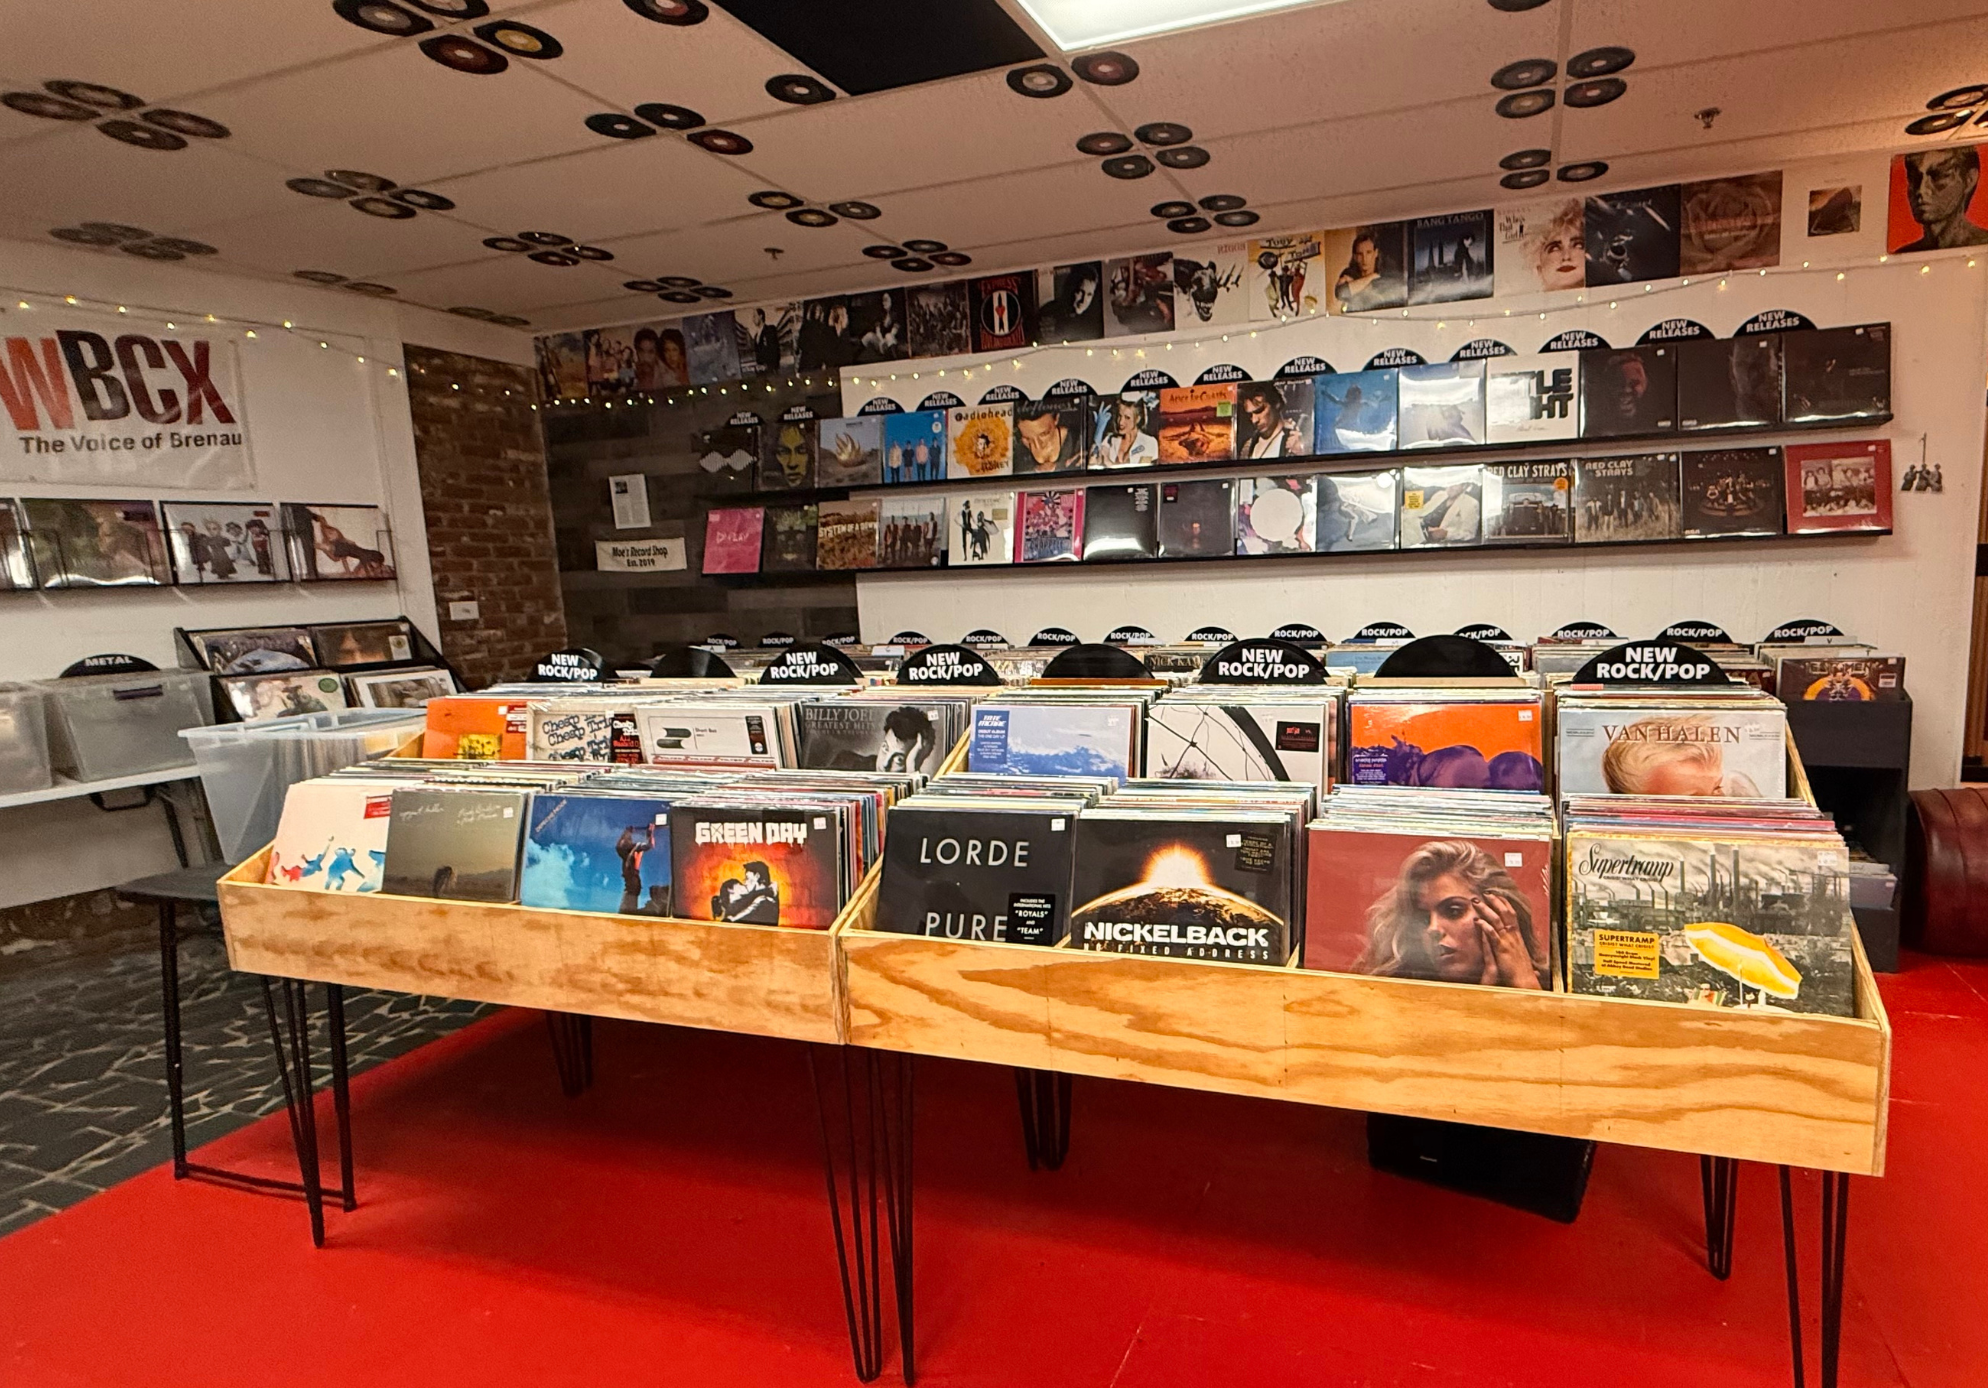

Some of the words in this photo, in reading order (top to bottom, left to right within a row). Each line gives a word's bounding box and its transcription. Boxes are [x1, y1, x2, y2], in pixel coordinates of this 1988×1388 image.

[1759, 311, 1785, 322] NEW
[1662, 319, 1687, 330] NEW
[1746, 317, 1801, 332] RELEASES
[1561, 331, 1586, 340] NEW
[1649, 326, 1700, 339] RELEASES
[1471, 340, 1494, 349] NEW
[1550, 338, 1599, 350] RELEASES
[1384, 350, 1406, 358] NEW
[1460, 346, 1506, 357] RELEASES
[1294, 357, 1316, 366] NEW
[1373, 355, 1417, 366] RELEASES
[1212, 364, 1232, 373] NEW
[1284, 362, 1326, 373] RELEASES
[1140, 370, 1158, 379] NEW
[1203, 371, 1243, 382] RELEASES
[0, 330, 237, 431] WBCX
[1060, 379, 1078, 387] NEW
[1130, 377, 1168, 387] RELEASES
[1051, 385, 1087, 395] RELEASES
[985, 392, 1019, 401] RELEASES
[865, 403, 896, 412] RELEASES
[924, 398, 957, 407] RELEASES
[730, 416, 759, 425] RELEASES
[783, 411, 813, 420] RELEASES
[18, 437, 65, 454] The
[70, 435, 135, 451] Voice
[141, 434, 162, 449] of
[170, 432, 242, 448] Brenau
[1507, 464, 1529, 478] CLAY
[1532, 463, 1568, 478] STRAYS
[1585, 462, 1606, 471] RED
[1608, 460, 1634, 469] CLAY
[1595, 467, 1634, 477] STRAYS
[819, 525, 846, 538] SYSTEM
[612, 547, 629, 557] Moe's
[631, 546, 651, 557] Record
[652, 545, 668, 558] Shop
[1110, 631, 1151, 640] ROCK/POP
[1191, 632, 1234, 641] ROCK/POP
[1273, 629, 1319, 639] ROCK/POP
[1361, 627, 1408, 637] ROCK/POP
[1456, 628, 1501, 640] CK/POP
[1557, 628, 1610, 639] ROCK/POP
[1666, 627, 1723, 638] ROCK/POP
[1773, 625, 1834, 638] ROCK/POP
[762, 637, 795, 645] ROCK/POP
[892, 636, 929, 645] ROCK/POP
[965, 634, 1002, 643] ROCK/POP
[1037, 632, 1076, 643] ROCK/POP
[552, 652, 579, 665] NEW
[786, 651, 817, 666] NEW
[926, 651, 960, 667] NEW
[1241, 648, 1284, 663] NEW
[1625, 647, 1677, 663] NEW
[84, 656, 133, 666] METAL
[538, 663, 598, 681] ROCK/POP
[770, 663, 839, 680] ROCK/POP
[908, 663, 983, 681] ROCK/POP
[1218, 661, 1310, 679] ROCK/POP
[1596, 662, 1711, 681] ROCK/POP
[805, 708, 841, 721] BILLY
[542, 715, 580, 736] Cheap
[805, 721, 850, 730] GREATEST
[548, 726, 585, 746] Cheap
[1602, 724, 1651, 743] VAN
[1656, 725, 1742, 745] HALEN
[695, 822, 763, 845] GREEN
[766, 822, 807, 846] DAY
[920, 836, 1030, 868] LORDE
[1579, 843, 1674, 882] Supertramp
[1015, 910, 1048, 918] "ROYALS"
[925, 913, 1008, 942] PURE
[1084, 921, 1269, 947] NICKELBACK
[1598, 934, 1655, 944] SUPERTRAMP
[1118, 944, 1170, 955] FIXED
[1187, 946, 1269, 960] ADDRESS
